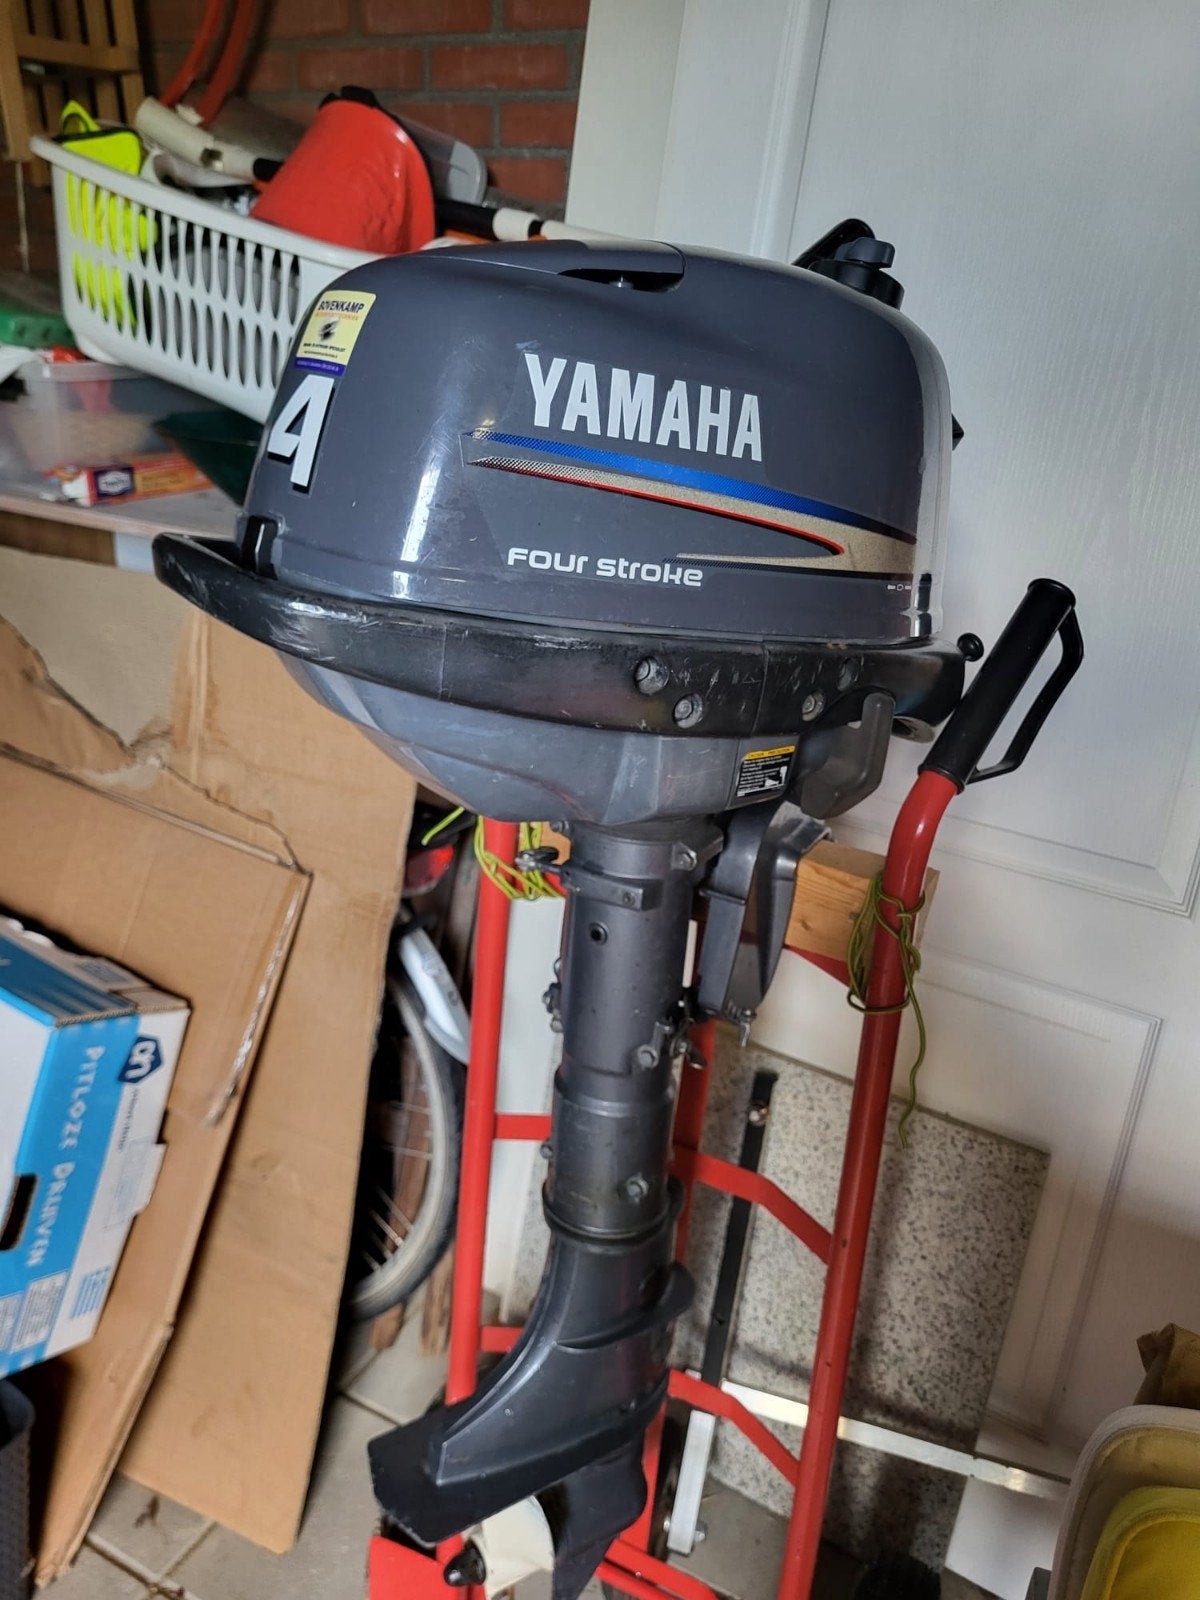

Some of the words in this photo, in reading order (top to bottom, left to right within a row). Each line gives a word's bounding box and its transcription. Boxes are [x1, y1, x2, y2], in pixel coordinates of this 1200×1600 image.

[318, 300, 365, 313] BOVENKAMP
[267, 374, 335, 493] 4
[524, 353, 762, 463] YAMAHA
[62, 1045, 107, 1149] PITLOZE
[28, 1161, 75, 1267] DRUIVEN
